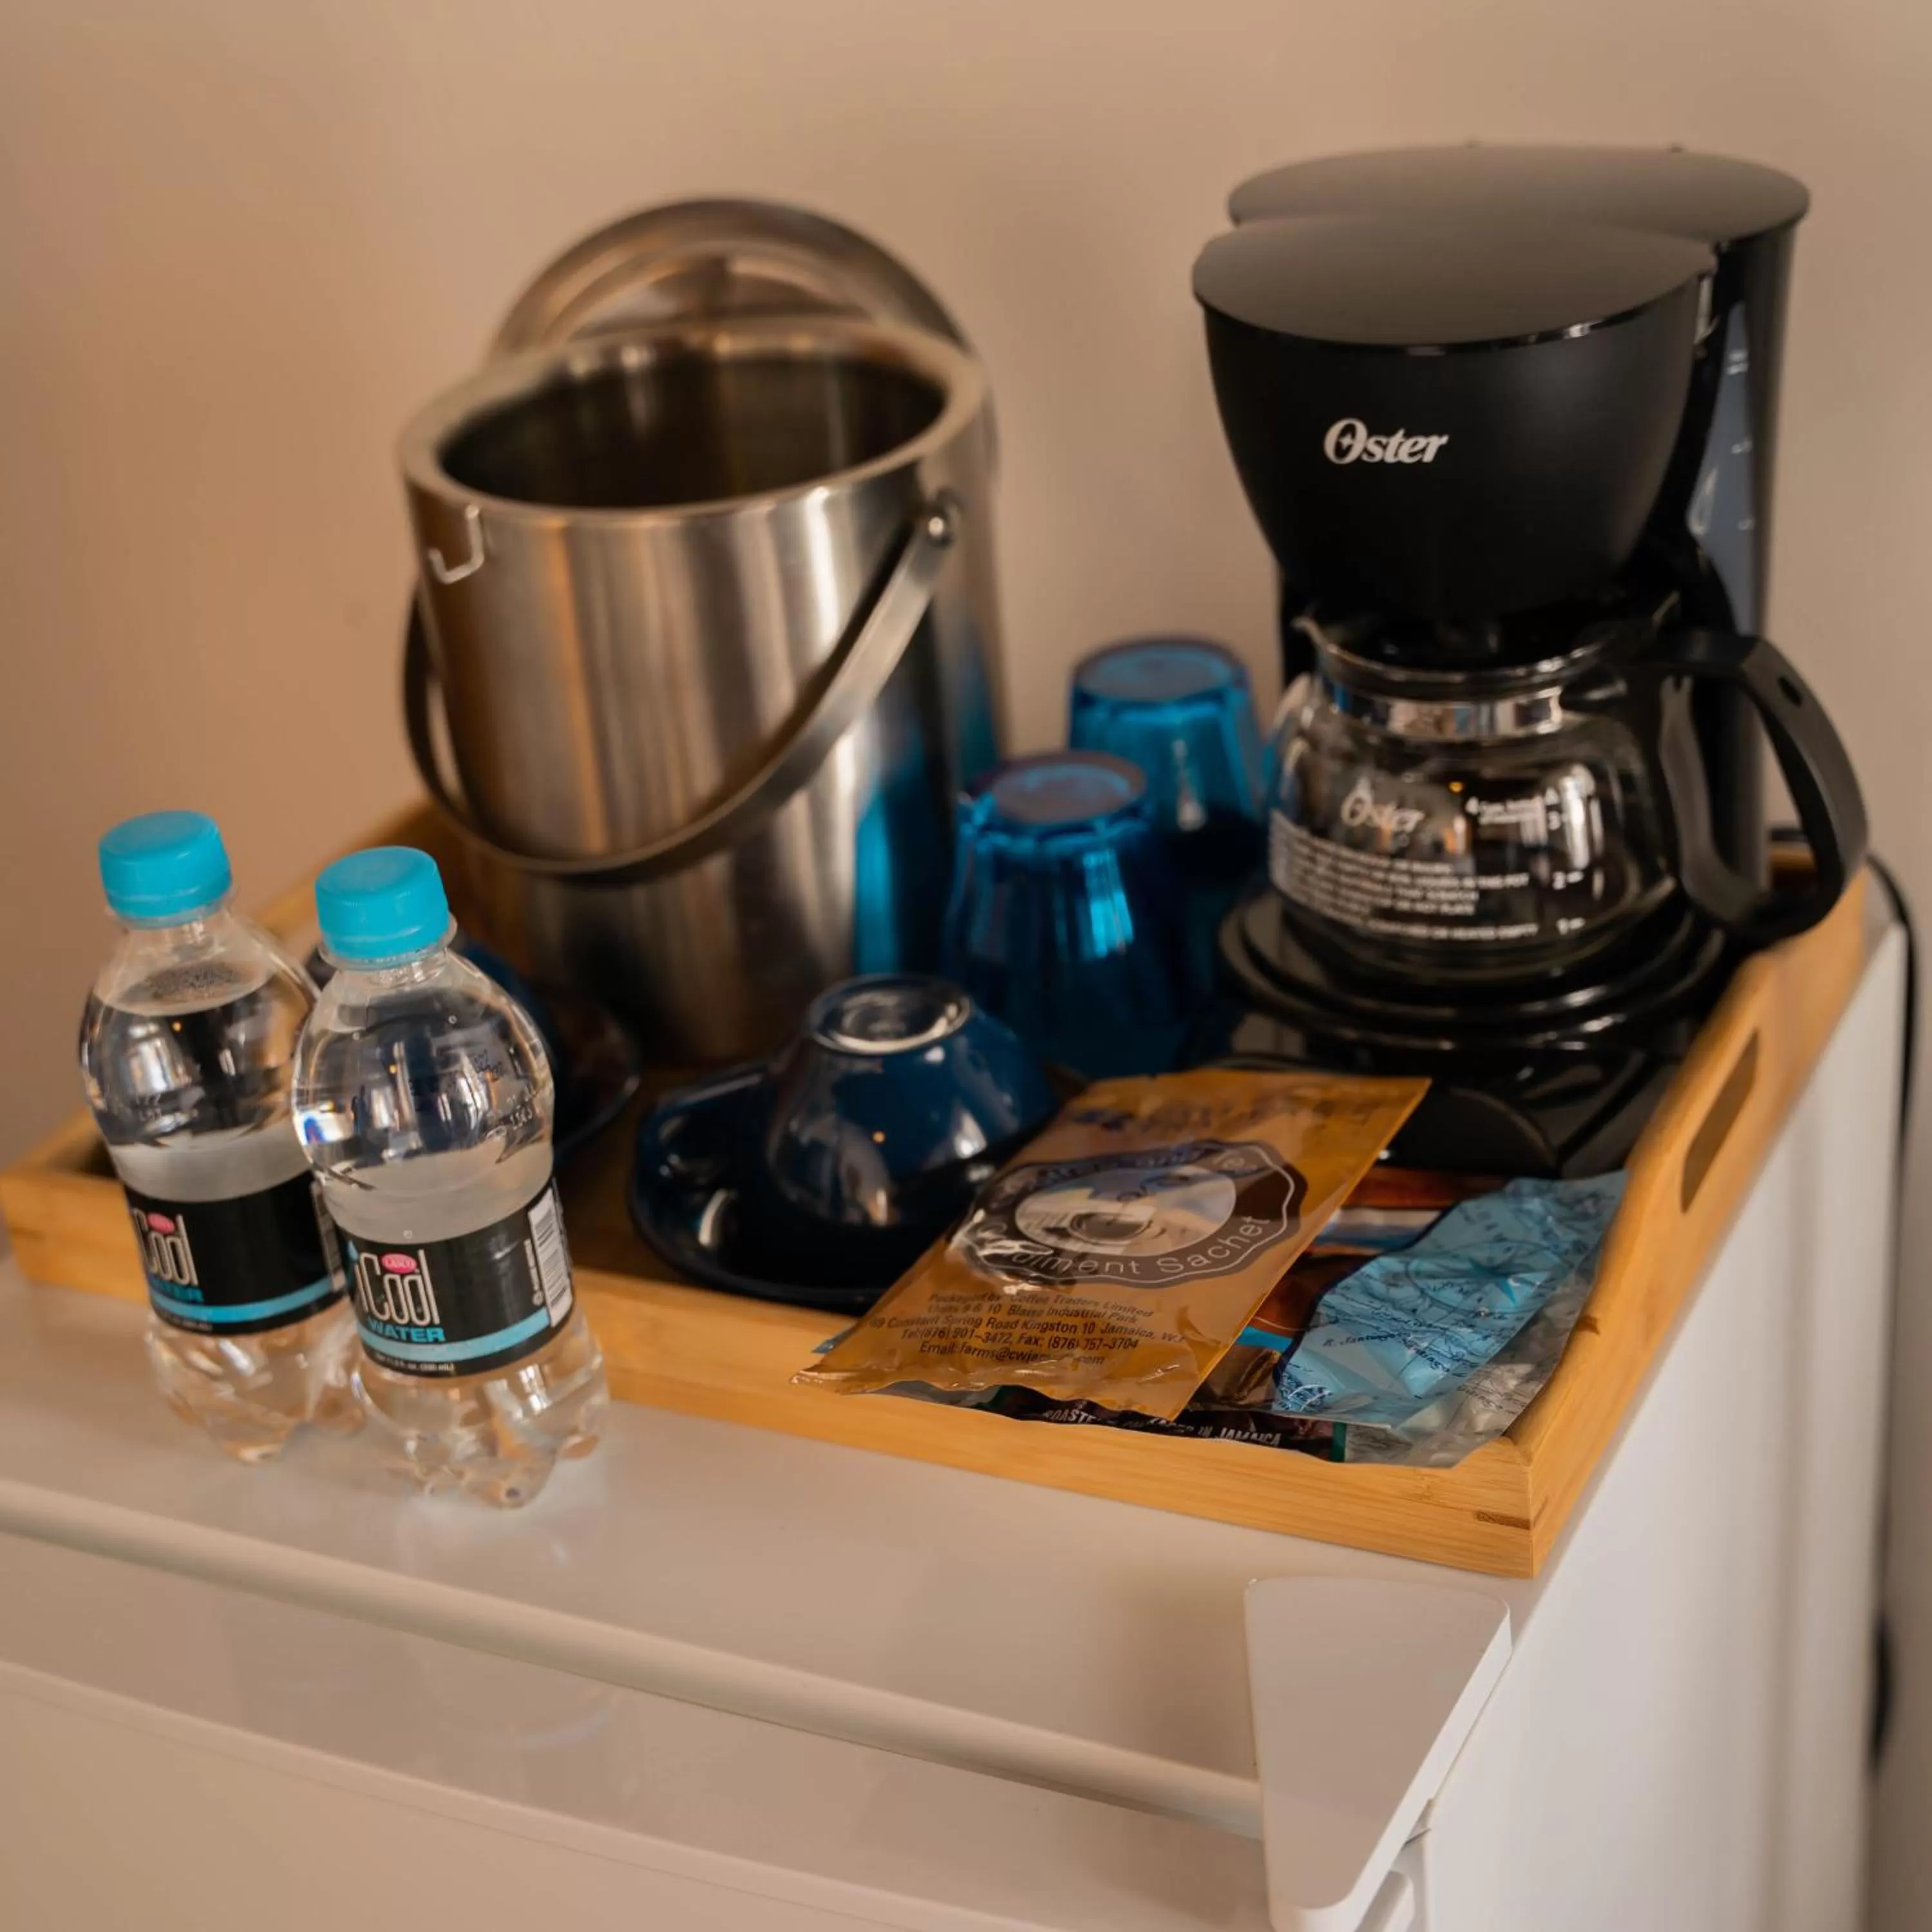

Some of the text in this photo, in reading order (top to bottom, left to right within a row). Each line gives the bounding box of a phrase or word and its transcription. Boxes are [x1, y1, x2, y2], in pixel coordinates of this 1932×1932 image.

[1323, 417, 1450, 464] Oster
[1155, 1215, 1272, 1274] Sachet
[368, 1316, 446, 1343] WATER
[985, 1316, 1019, 1330] Road
[1020, 1321, 1077, 1334] Kingston
[1083, 1321, 1096, 1334] 10
